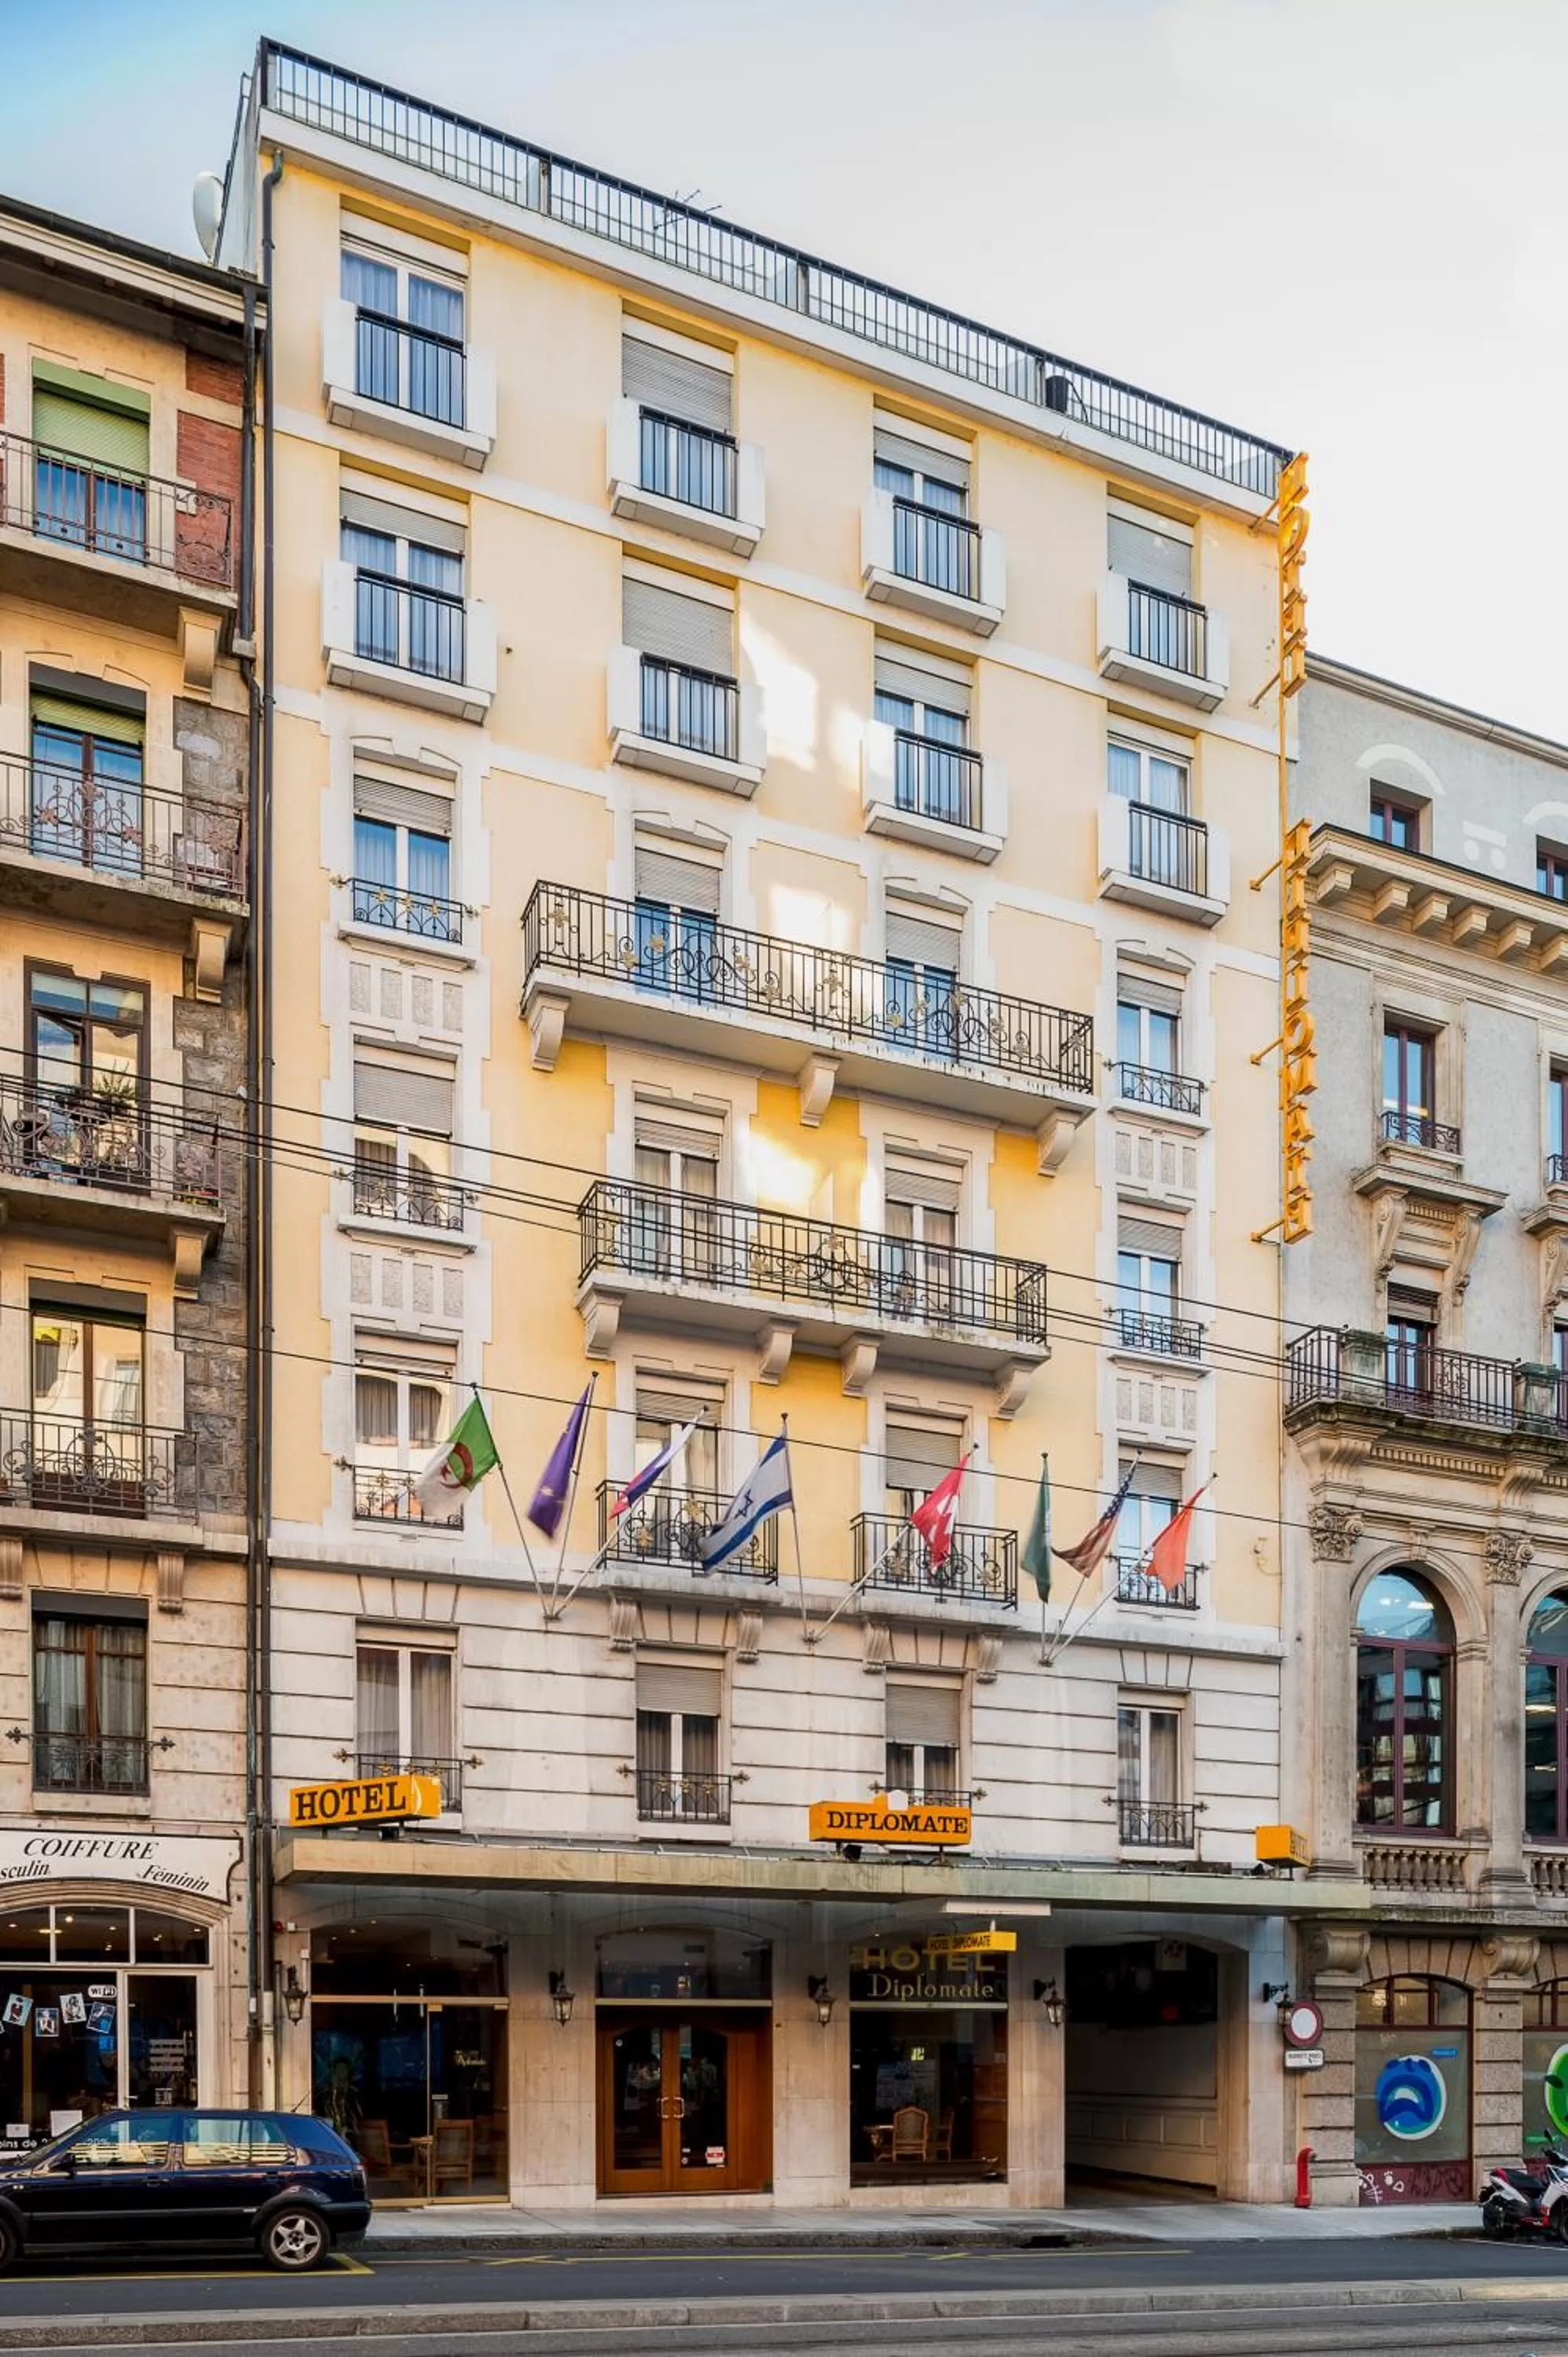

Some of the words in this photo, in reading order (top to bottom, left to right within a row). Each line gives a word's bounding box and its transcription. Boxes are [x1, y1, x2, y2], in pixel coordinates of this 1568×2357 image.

[295, 1782, 406, 1820] HOTEL
[827, 1810, 968, 1835] DIPLOMATE
[23, 1838, 159, 1860] COIFFURE
[142, 1864, 211, 1892] Féminin
[866, 1973, 995, 2000] Diplomate
[21, 2139, 38, 2149] de
